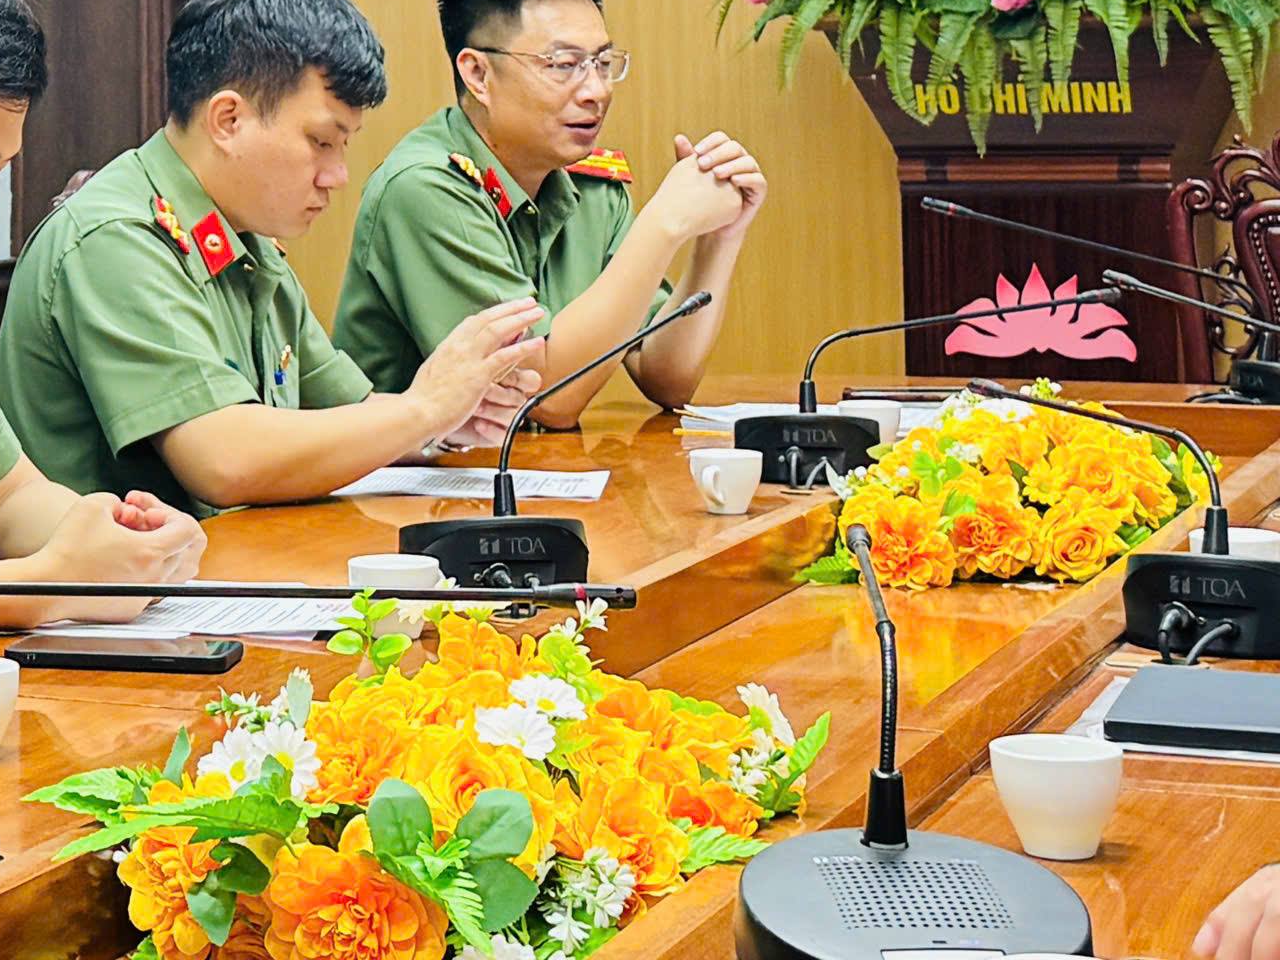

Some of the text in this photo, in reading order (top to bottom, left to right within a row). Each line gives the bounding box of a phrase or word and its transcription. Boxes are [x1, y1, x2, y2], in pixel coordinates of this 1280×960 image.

[1040, 80, 1133, 114] MINH
[505, 536, 547, 555] TOA
[1197, 576, 1247, 600] TOA
